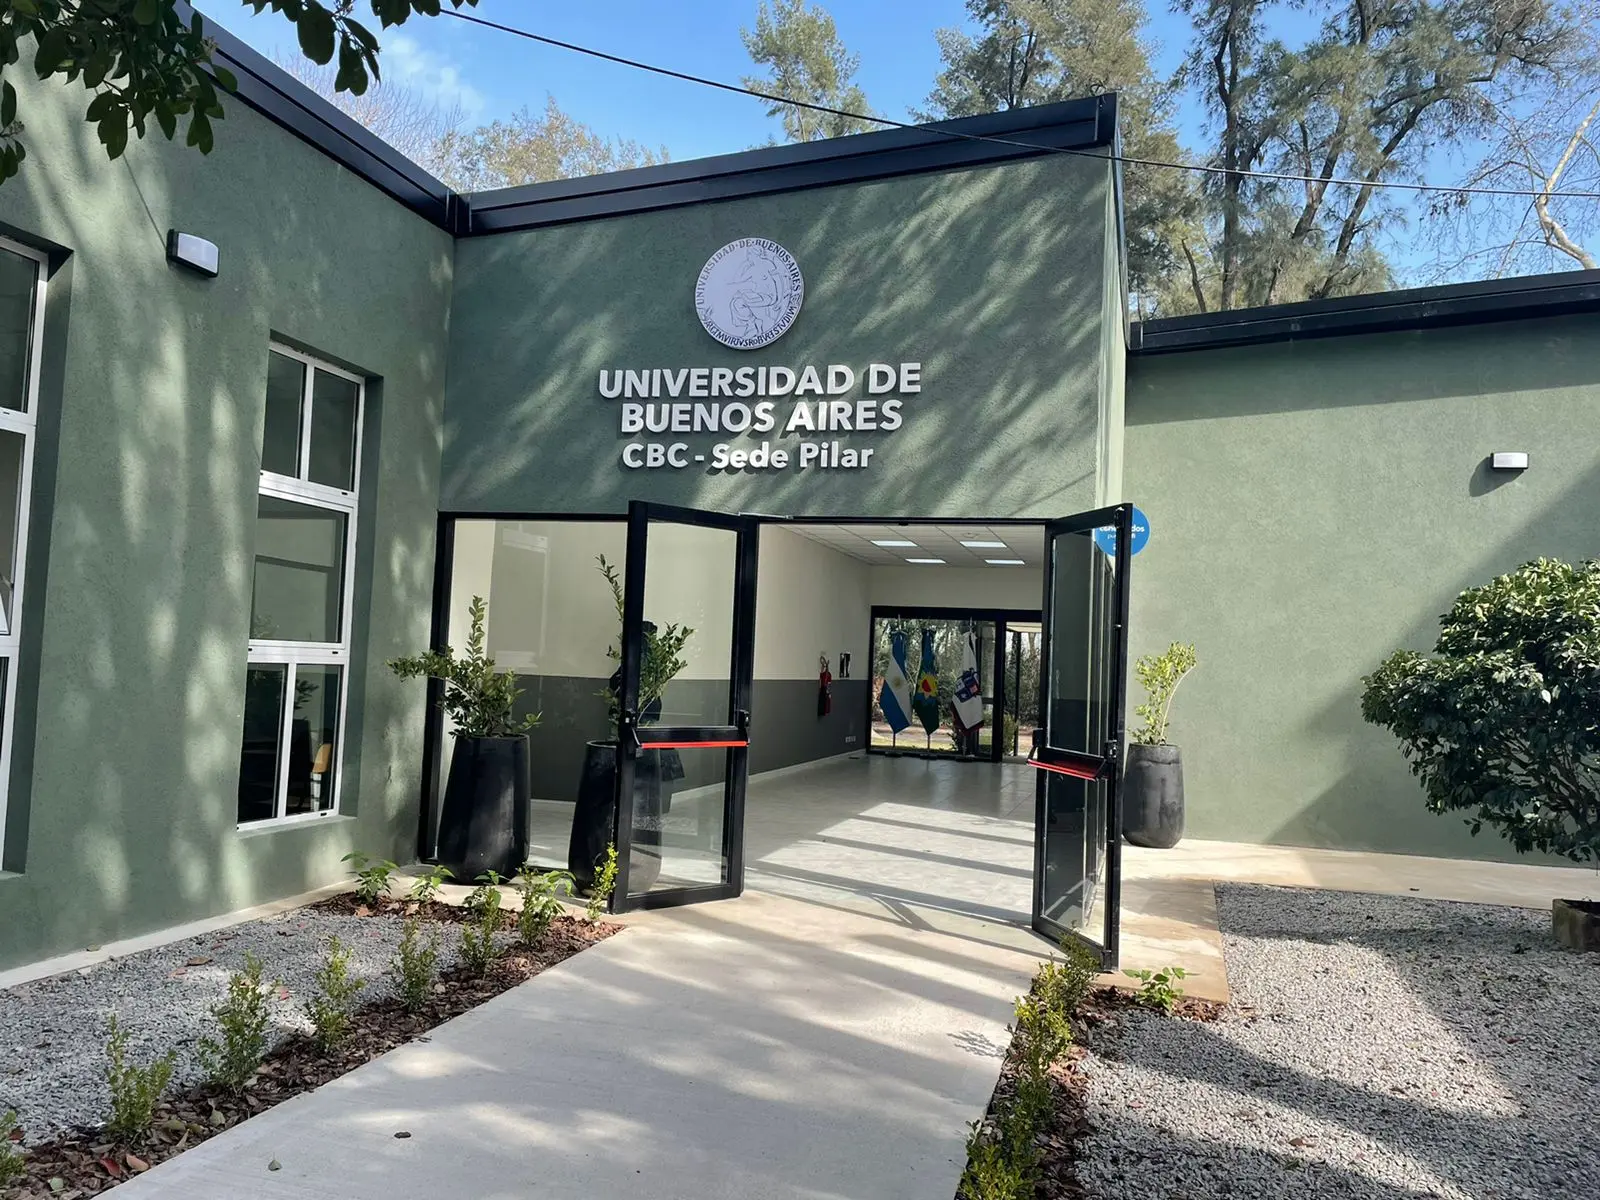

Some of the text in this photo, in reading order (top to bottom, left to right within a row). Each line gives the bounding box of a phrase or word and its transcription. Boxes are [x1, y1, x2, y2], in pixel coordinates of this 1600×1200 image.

[696, 243, 736, 305] UNIVERSIDAD
[738, 240, 752, 249] DE
[787, 261, 801, 292] AIRES
[599, 362, 922, 399] UNIVERSIDAD DE
[621, 400, 904, 434] BUENOS AIRES
[622, 443, 689, 469] CBC
[712, 442, 789, 469] Sede
[800, 441, 874, 467] Pilar
